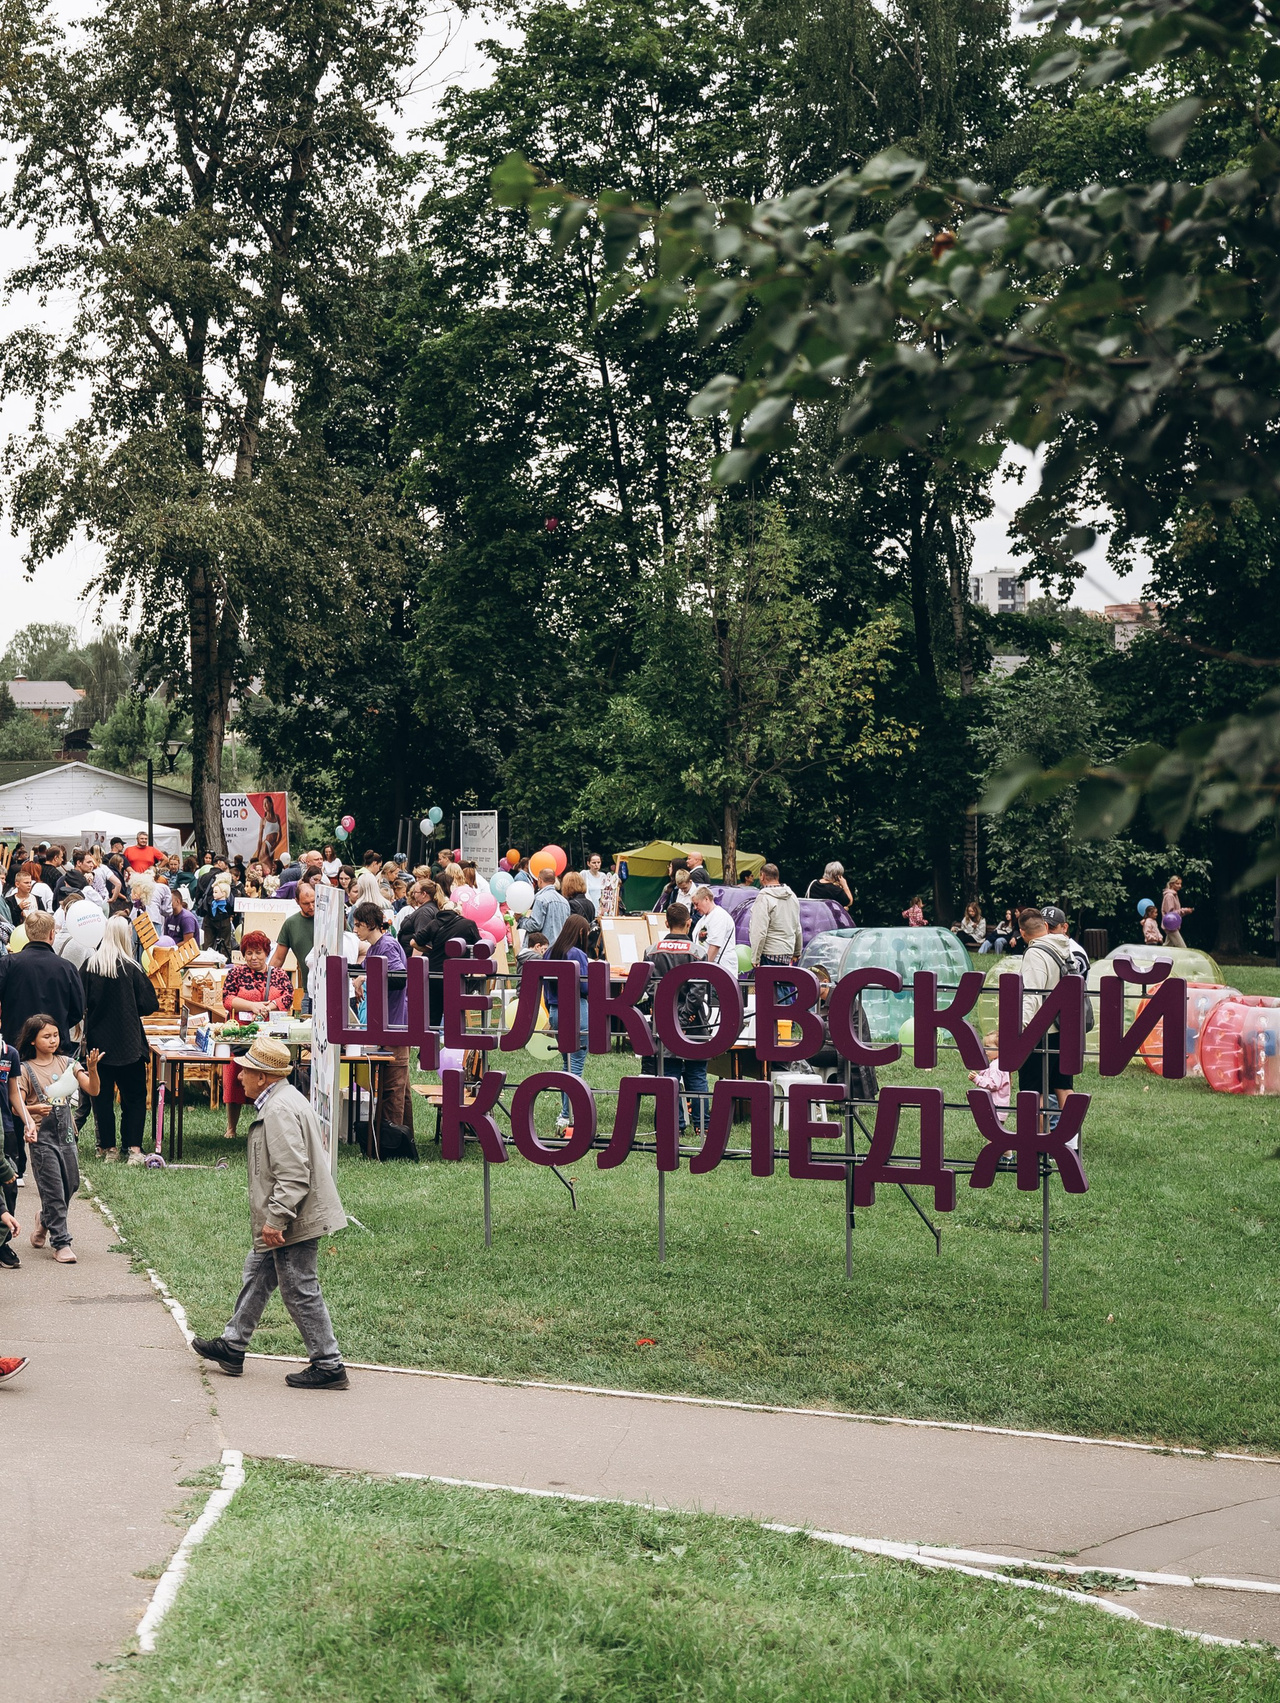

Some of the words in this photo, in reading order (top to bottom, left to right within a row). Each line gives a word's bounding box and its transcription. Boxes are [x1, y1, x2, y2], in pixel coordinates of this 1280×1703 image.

[220, 798, 247, 807] ссаж
[221, 809, 239, 819] ния
[659, 942, 688, 950] MOTUL
[326, 938, 1188, 1079] ЩЁЛКОВСКИЙ
[441, 1069, 1091, 1212] КОЛЛЕДЖ
